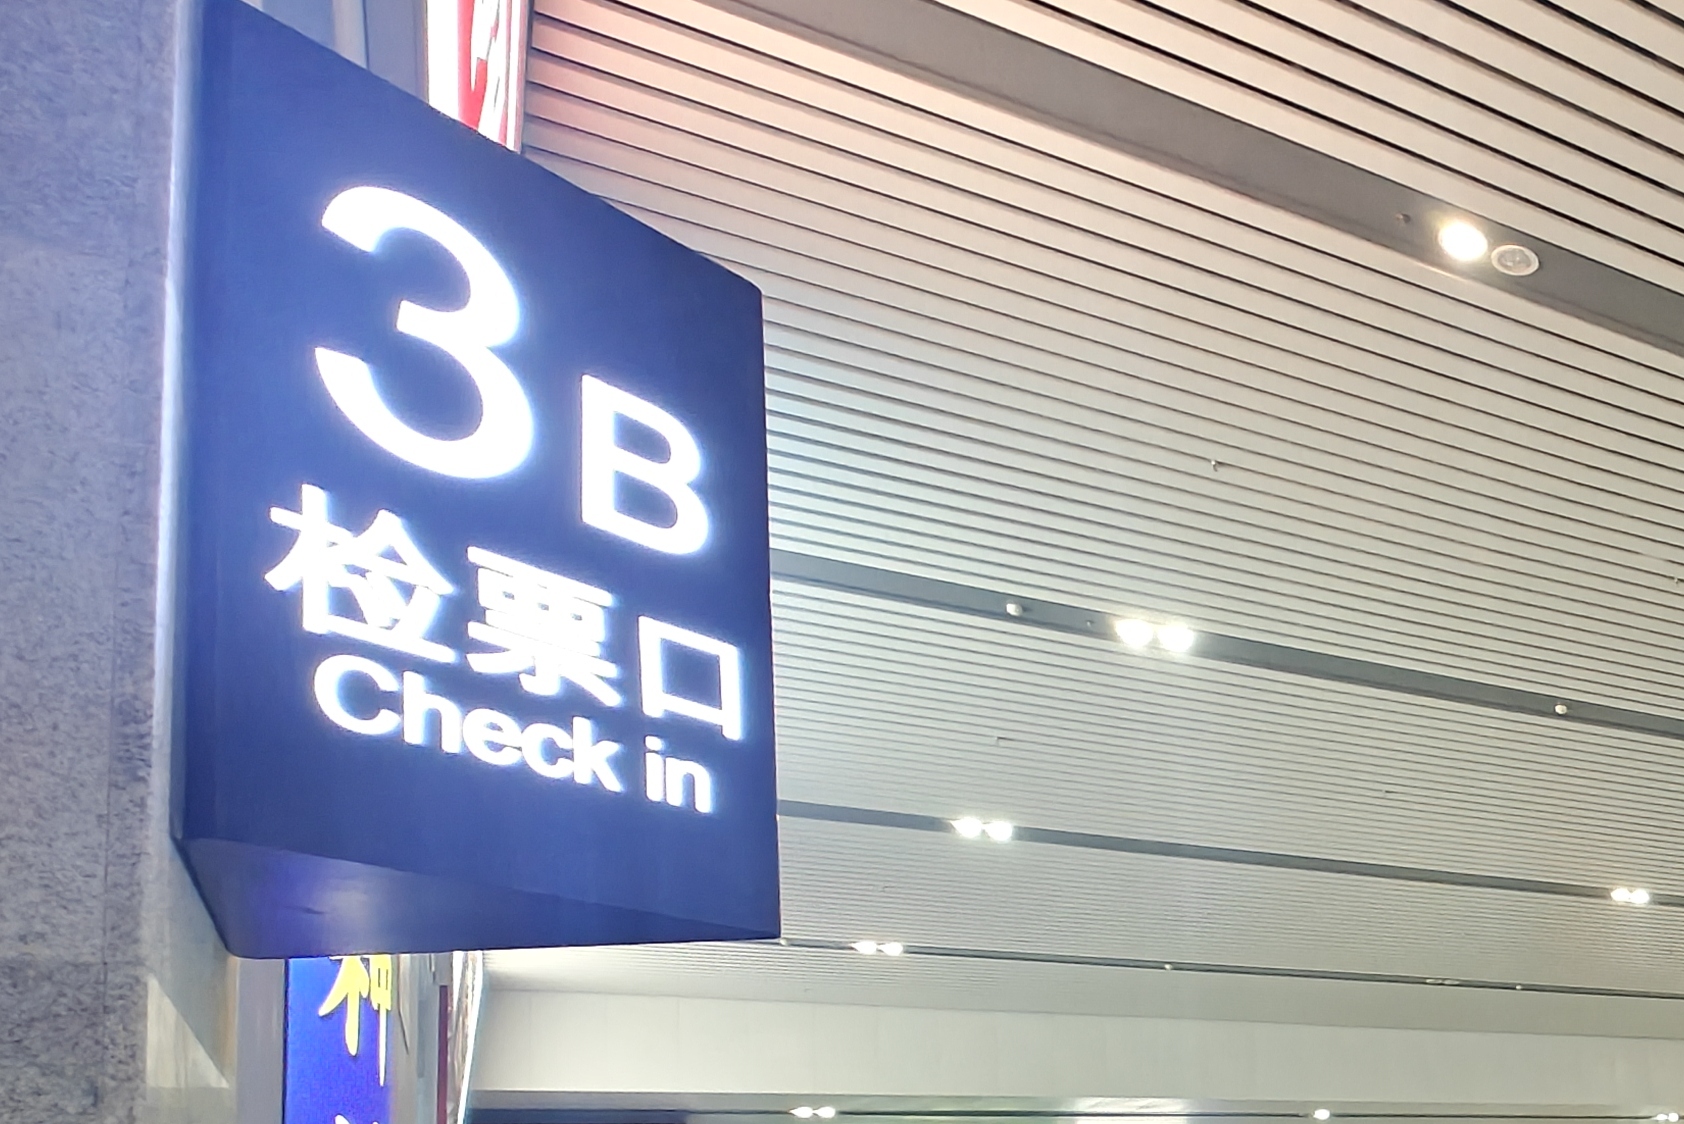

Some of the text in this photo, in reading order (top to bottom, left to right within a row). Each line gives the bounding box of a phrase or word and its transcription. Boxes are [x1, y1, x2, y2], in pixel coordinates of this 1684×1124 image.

[265, 483, 748, 743] 检票口
[313, 653, 713, 815] Check in
